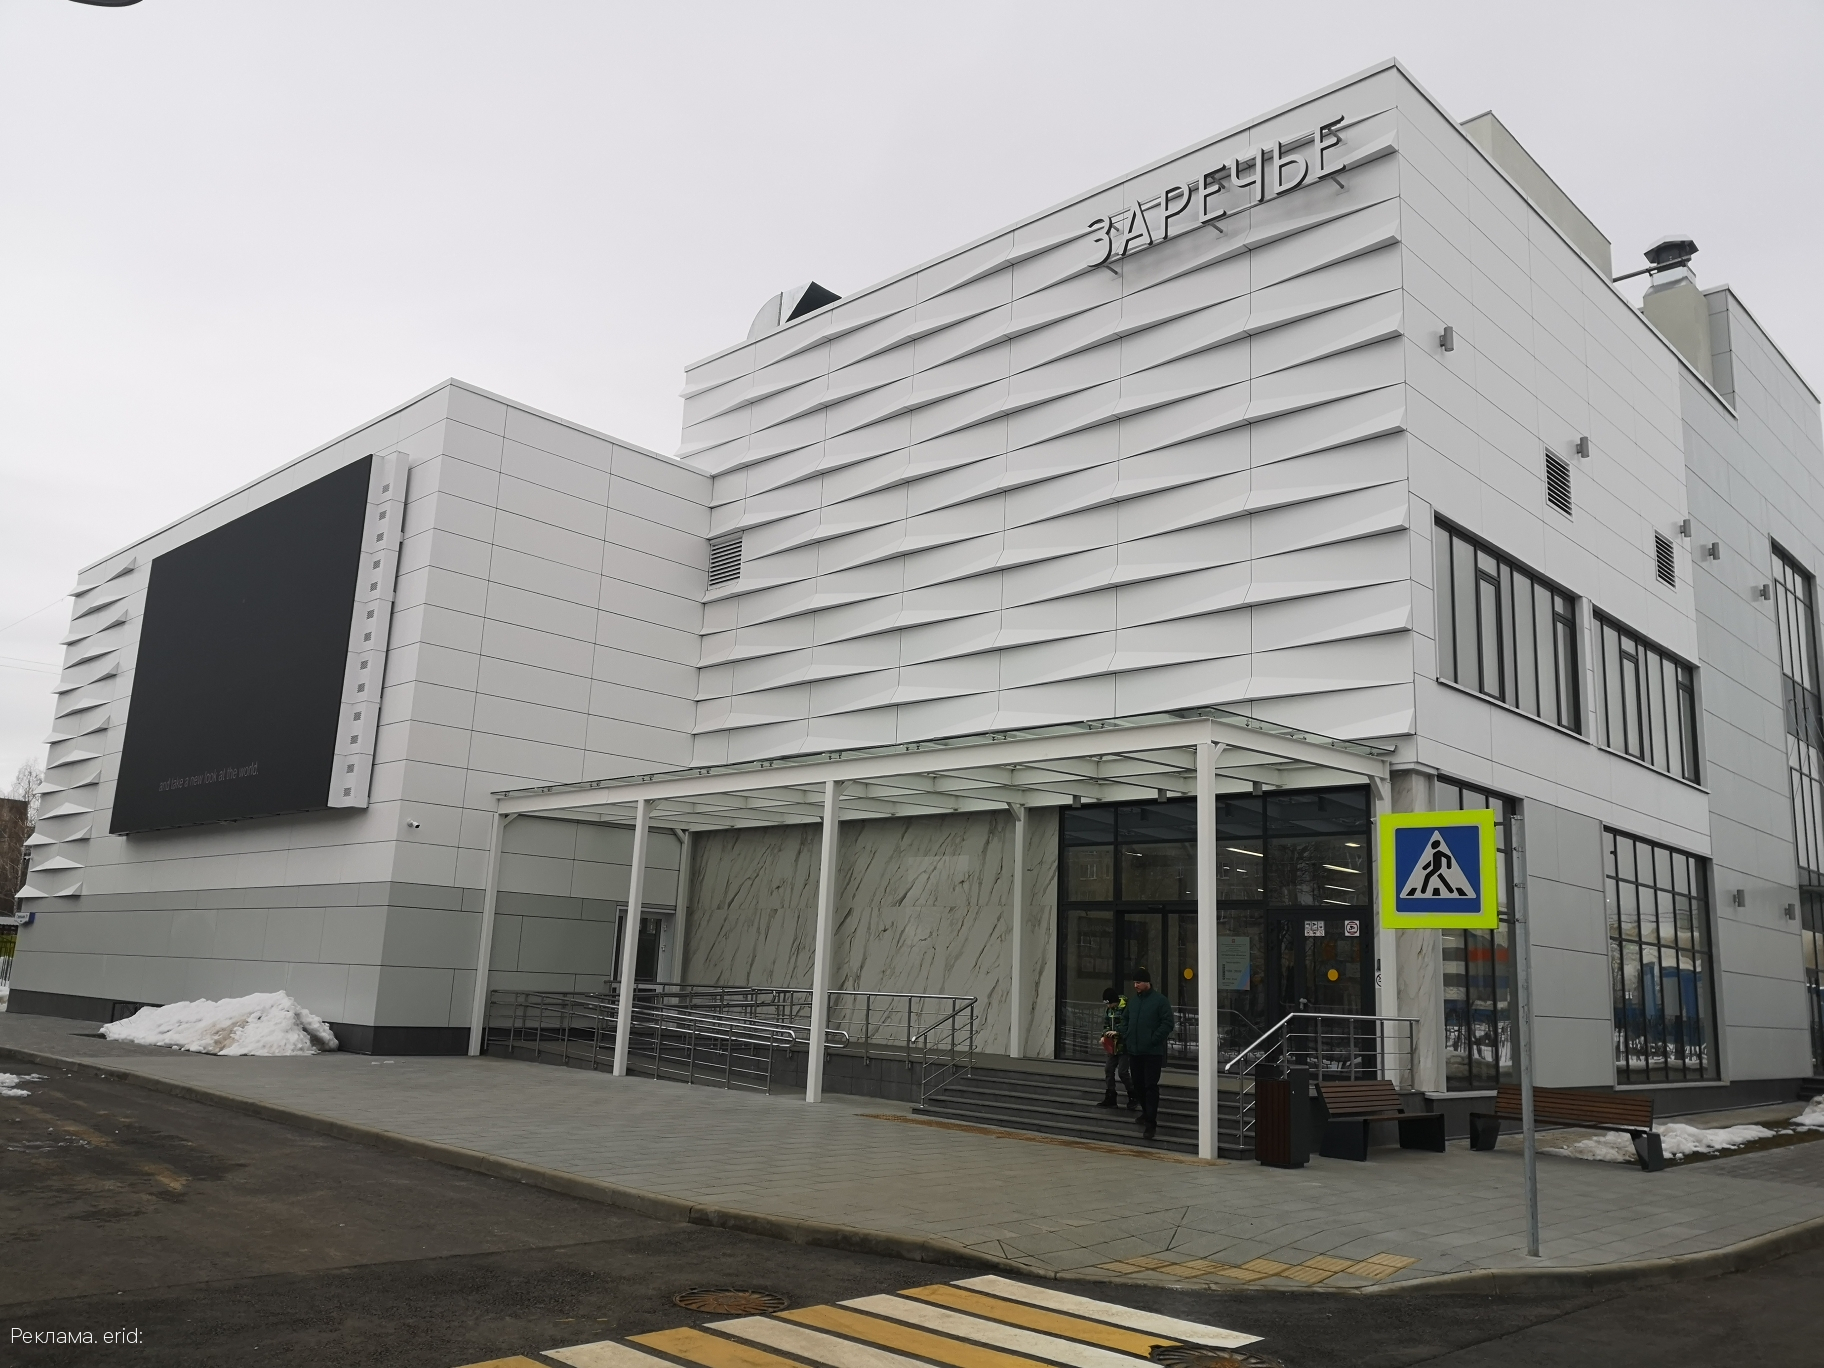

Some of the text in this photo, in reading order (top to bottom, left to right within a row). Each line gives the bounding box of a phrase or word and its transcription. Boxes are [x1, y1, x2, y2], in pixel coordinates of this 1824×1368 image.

[1087, 113, 1347, 267] ЗАРЕЧЬЕ
[158, 777, 171, 792] and
[171, 777, 184, 790] take
[189, 774, 204, 786] new
[204, 768, 218, 784] look
[218, 768, 226, 782] at
[226, 766, 238, 780] the
[238, 761, 260, 778] world.
